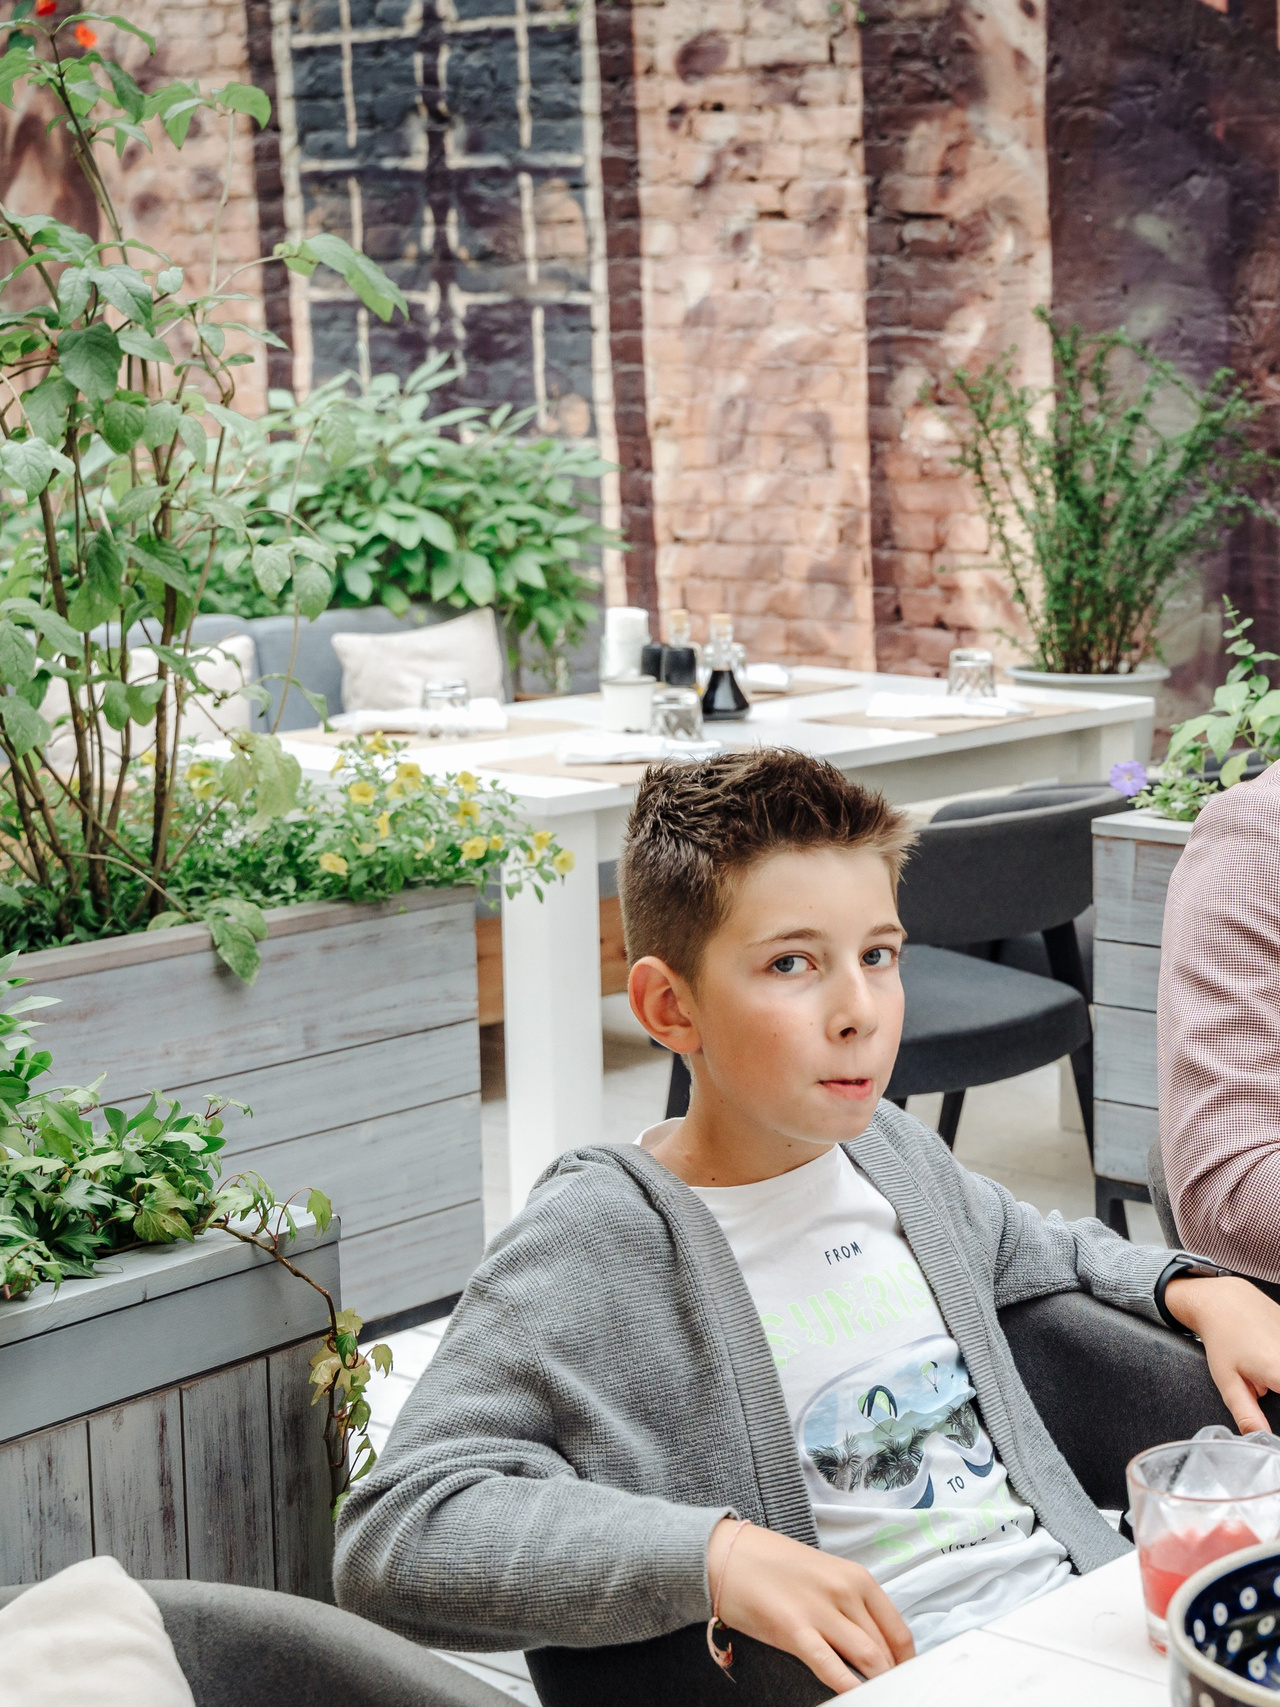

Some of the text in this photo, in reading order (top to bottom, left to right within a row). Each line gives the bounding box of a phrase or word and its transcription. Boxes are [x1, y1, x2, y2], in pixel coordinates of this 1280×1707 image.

[824, 1241, 863, 1265] FROM
[760, 1262, 932, 1369] SUNRIS
[946, 1475, 965, 1493] TO
